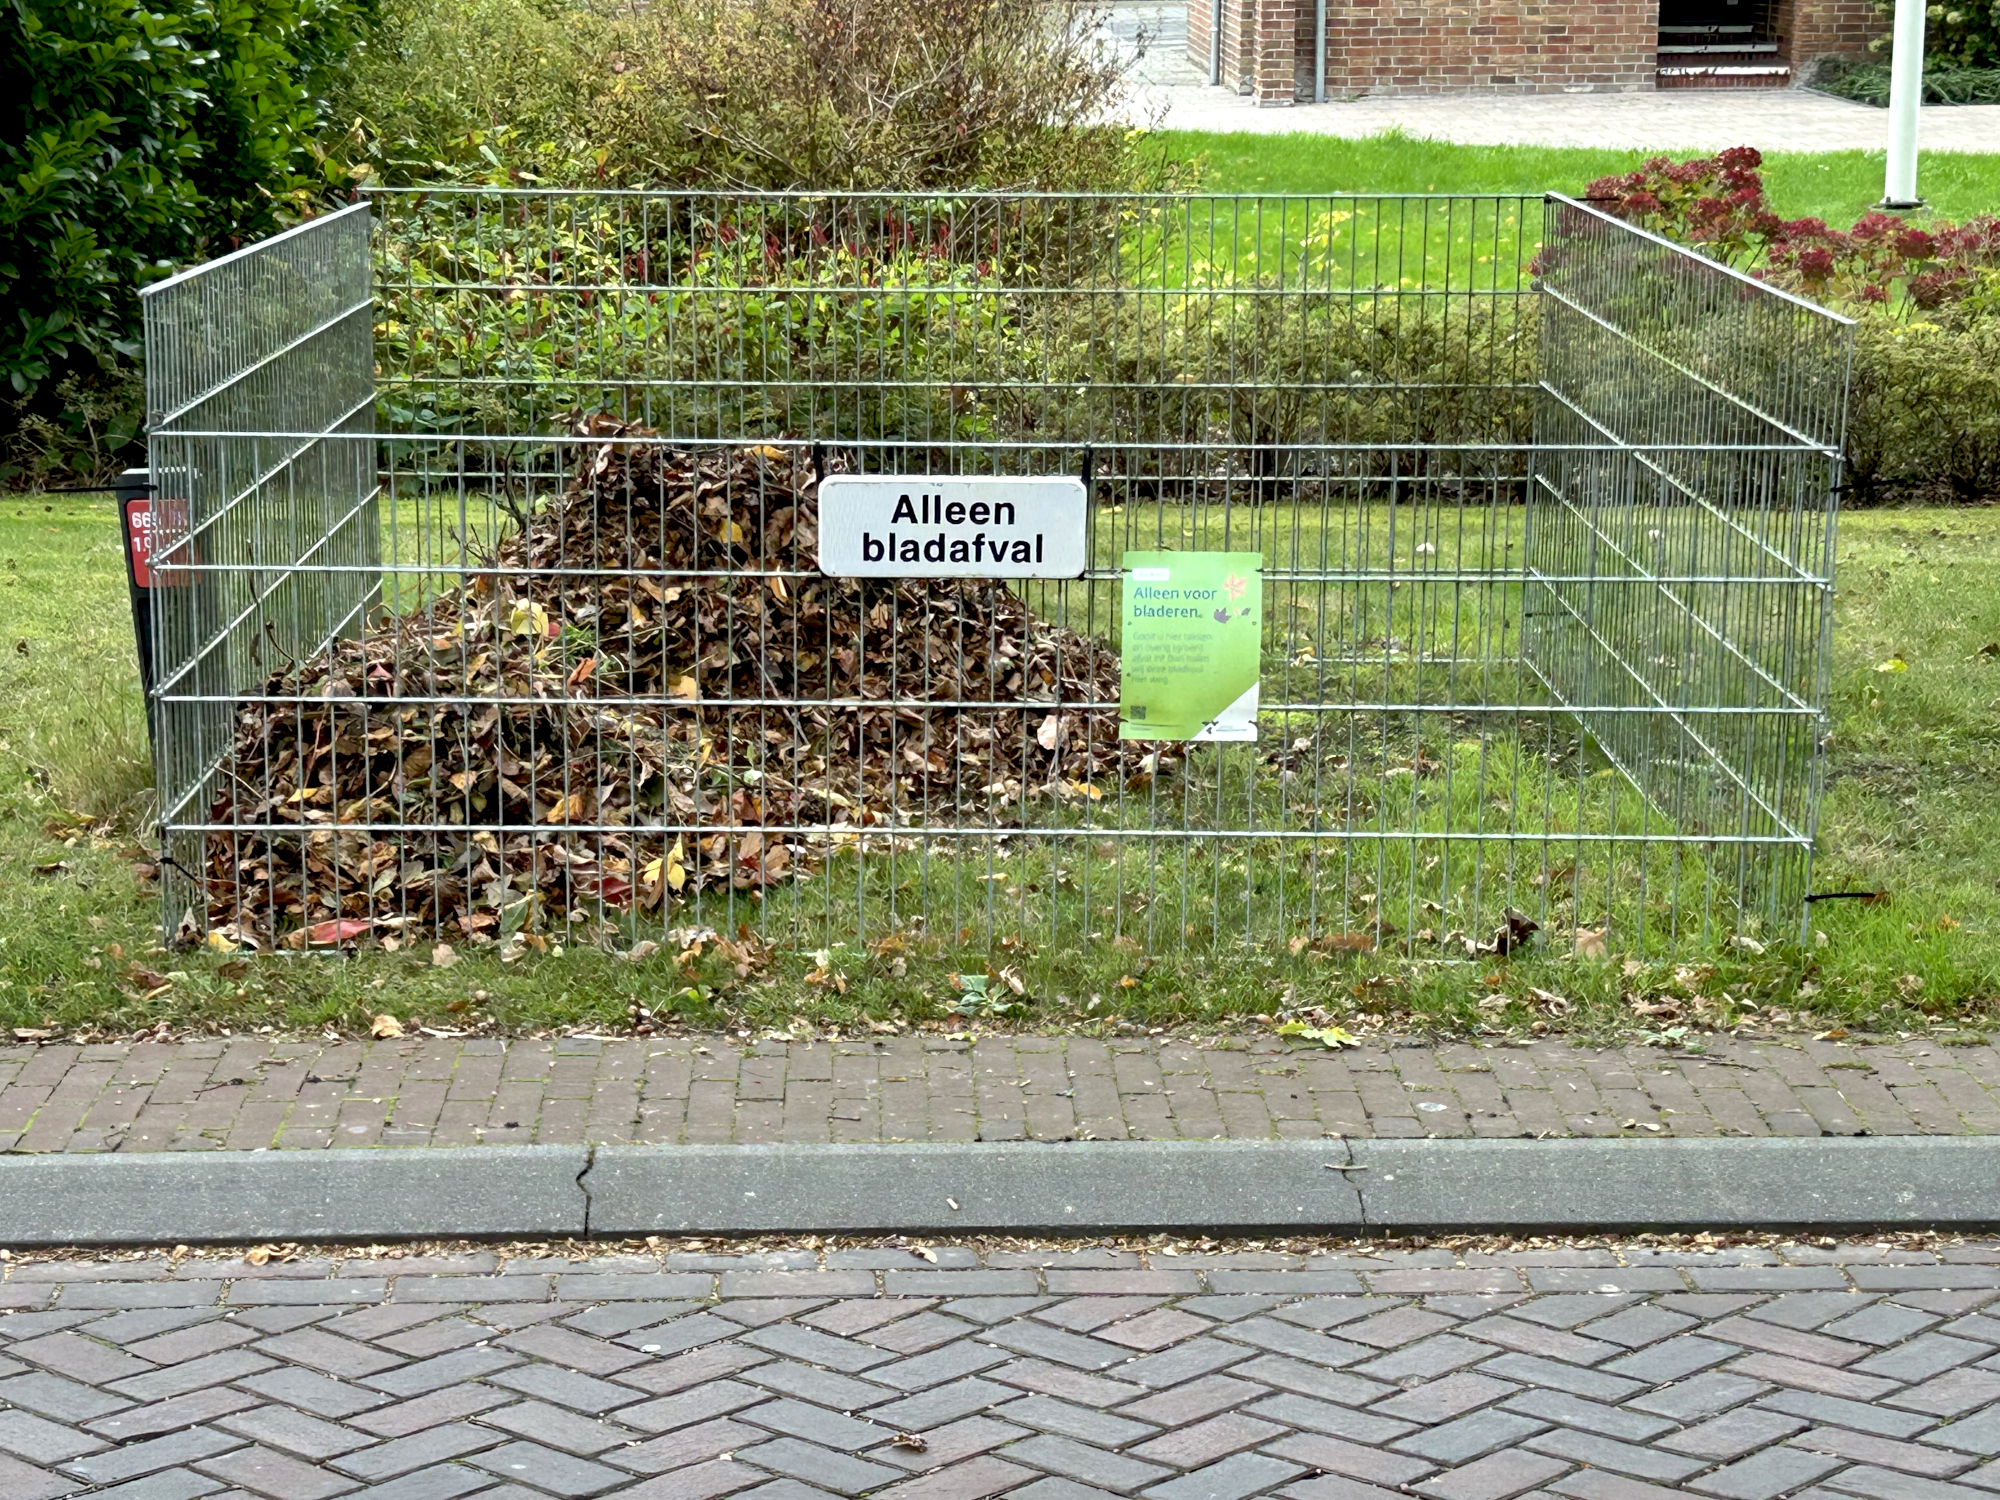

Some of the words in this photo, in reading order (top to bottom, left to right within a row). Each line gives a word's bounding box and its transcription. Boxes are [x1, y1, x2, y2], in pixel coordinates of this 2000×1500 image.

[891, 494, 1015, 525] Alleen
[863, 532, 1043, 563] bladafval
[1133, 586, 1179, 600] Alleen
[1183, 589, 1218, 601] voor
